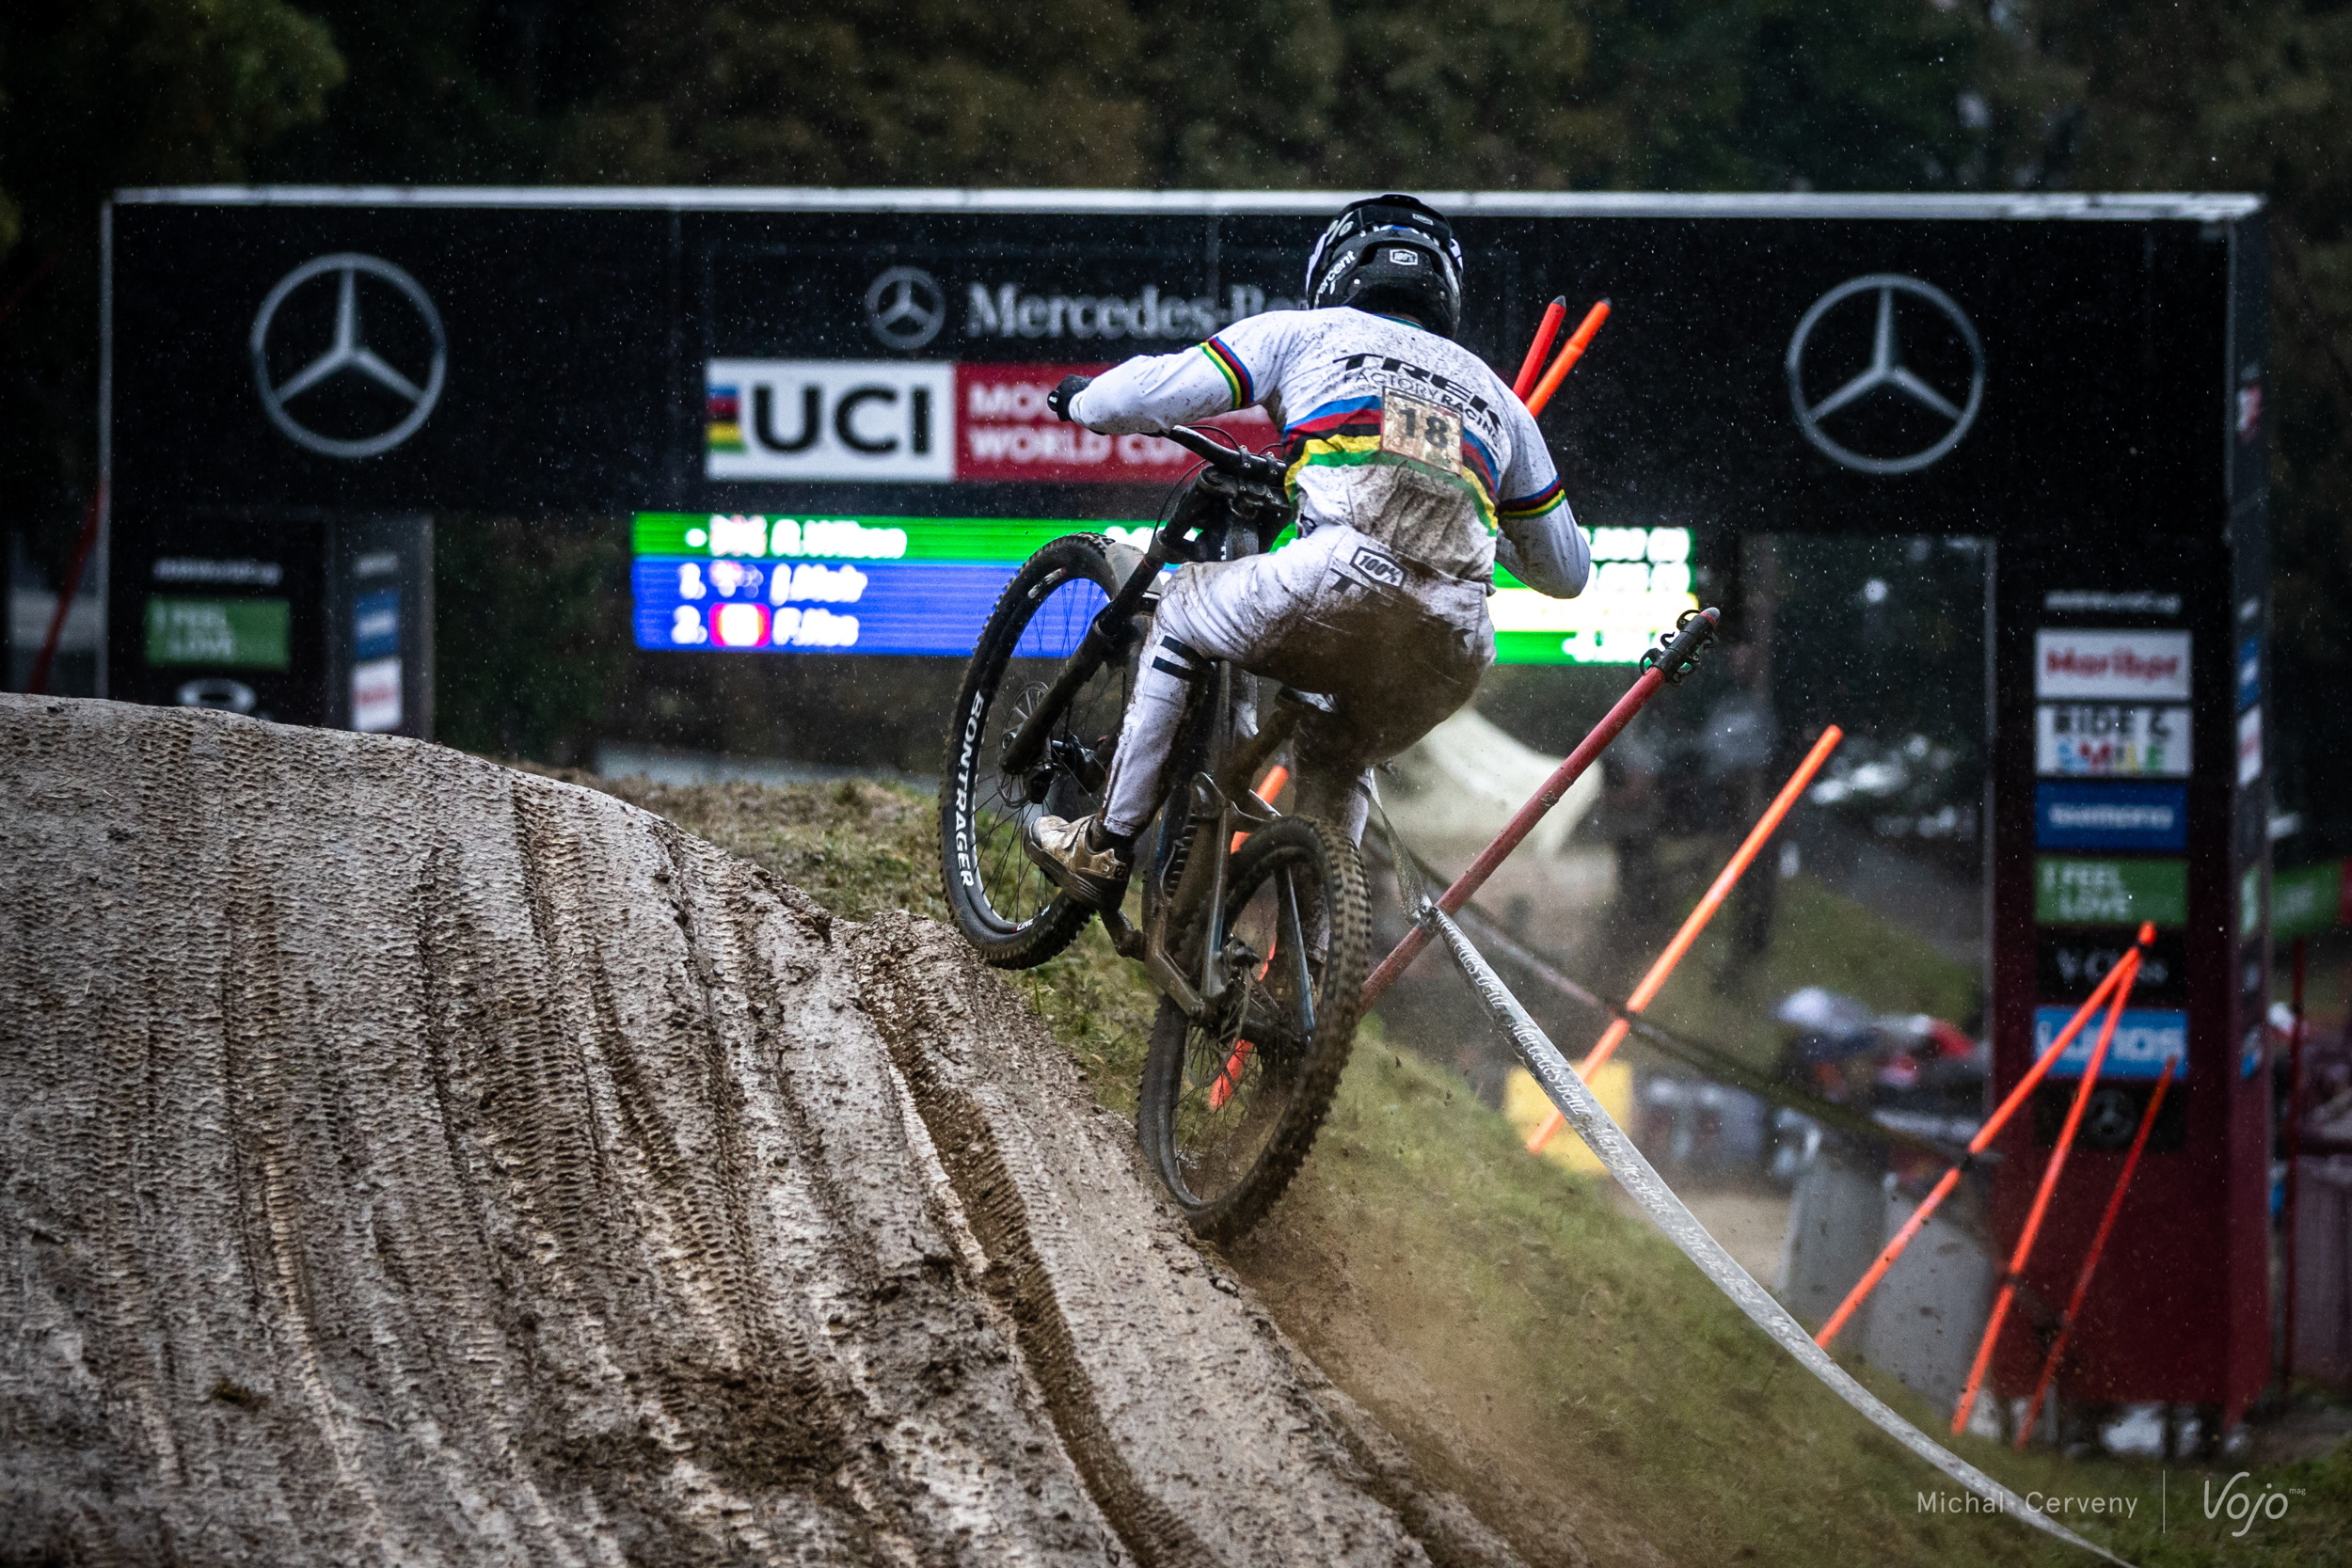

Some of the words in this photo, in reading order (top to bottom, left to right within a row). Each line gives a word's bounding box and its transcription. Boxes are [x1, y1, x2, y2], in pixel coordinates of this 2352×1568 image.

[755, 384, 931, 455] UCI
[1344, 371, 1439, 400] FACTORY
[1441, 393, 1502, 448] RACING
[1399, 406, 1450, 449] 18
[1358, 555, 1401, 584] 100%
[955, 689, 985, 888] BONTRAGER
[1508, 1022, 1593, 1116] Mercedes-Benz
